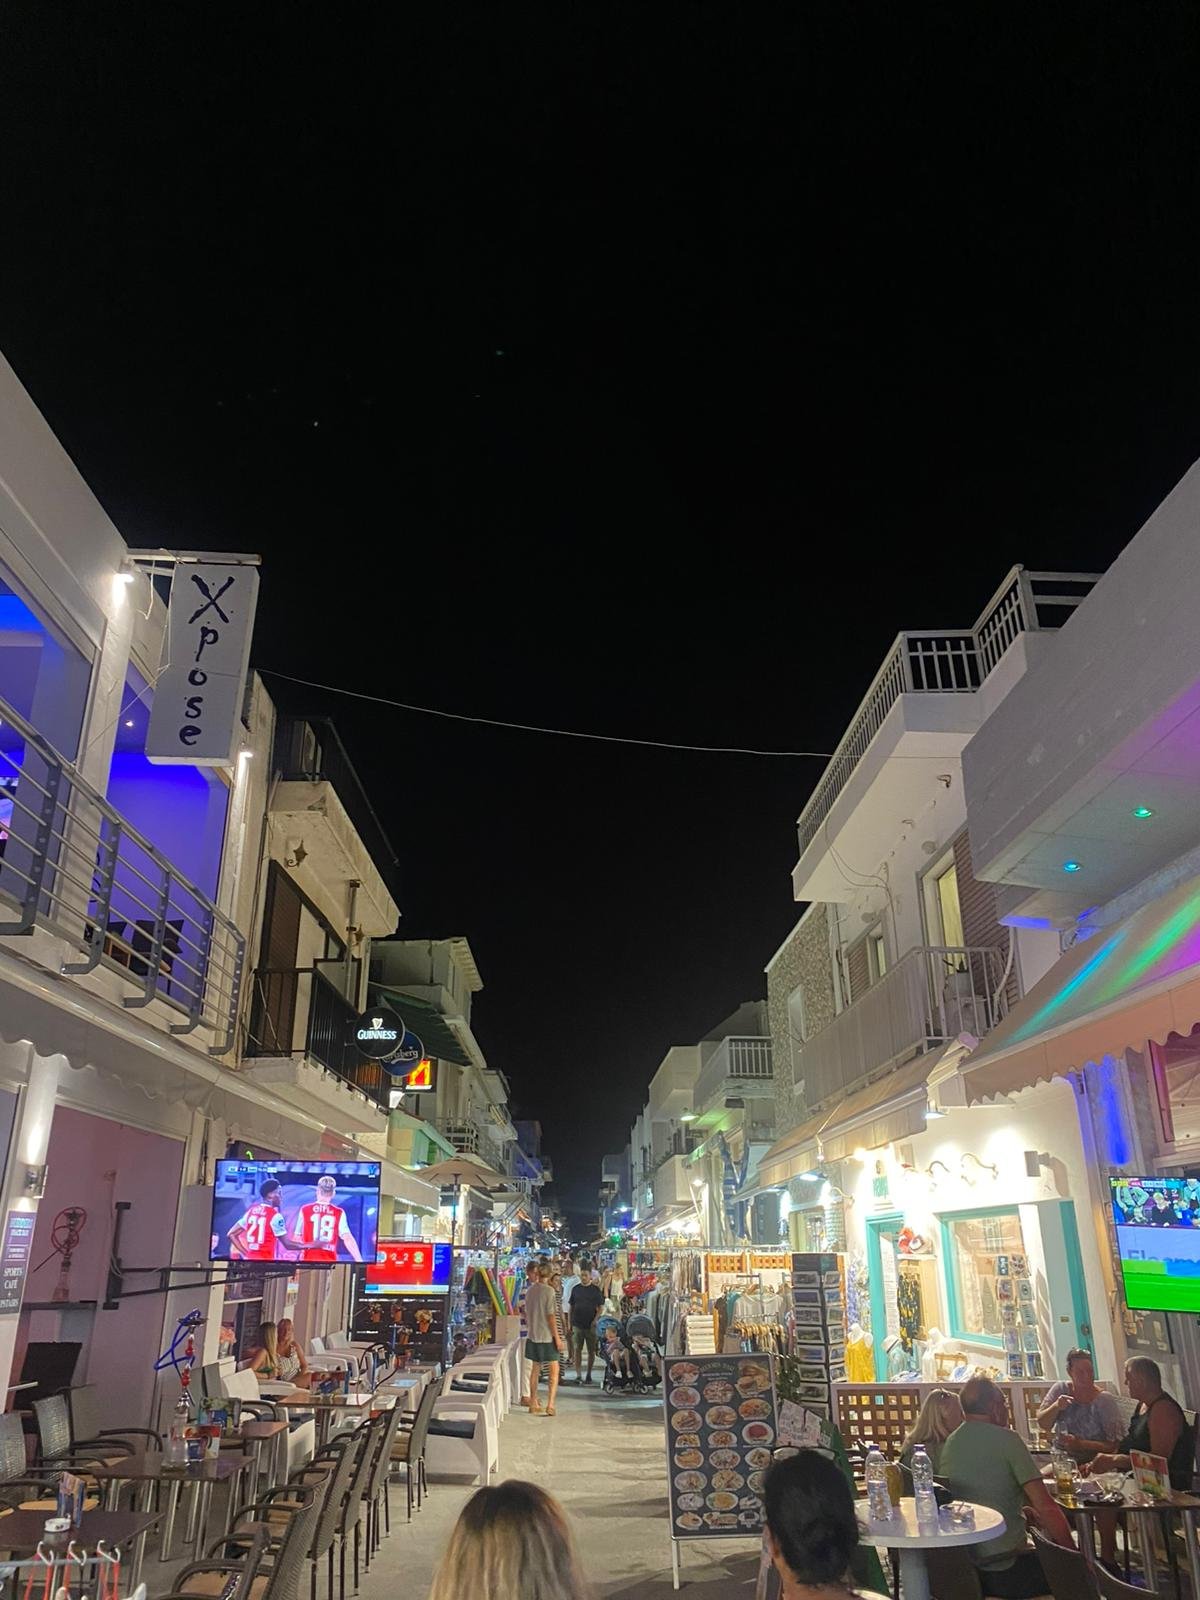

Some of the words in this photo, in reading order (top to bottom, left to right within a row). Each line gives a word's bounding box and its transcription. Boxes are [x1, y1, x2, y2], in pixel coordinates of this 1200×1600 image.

[178, 573, 236, 747] Xpose
[357, 1029, 398, 1040] GUINNESS
[246, 1214, 267, 1244] 21
[310, 1213, 336, 1243] 18
